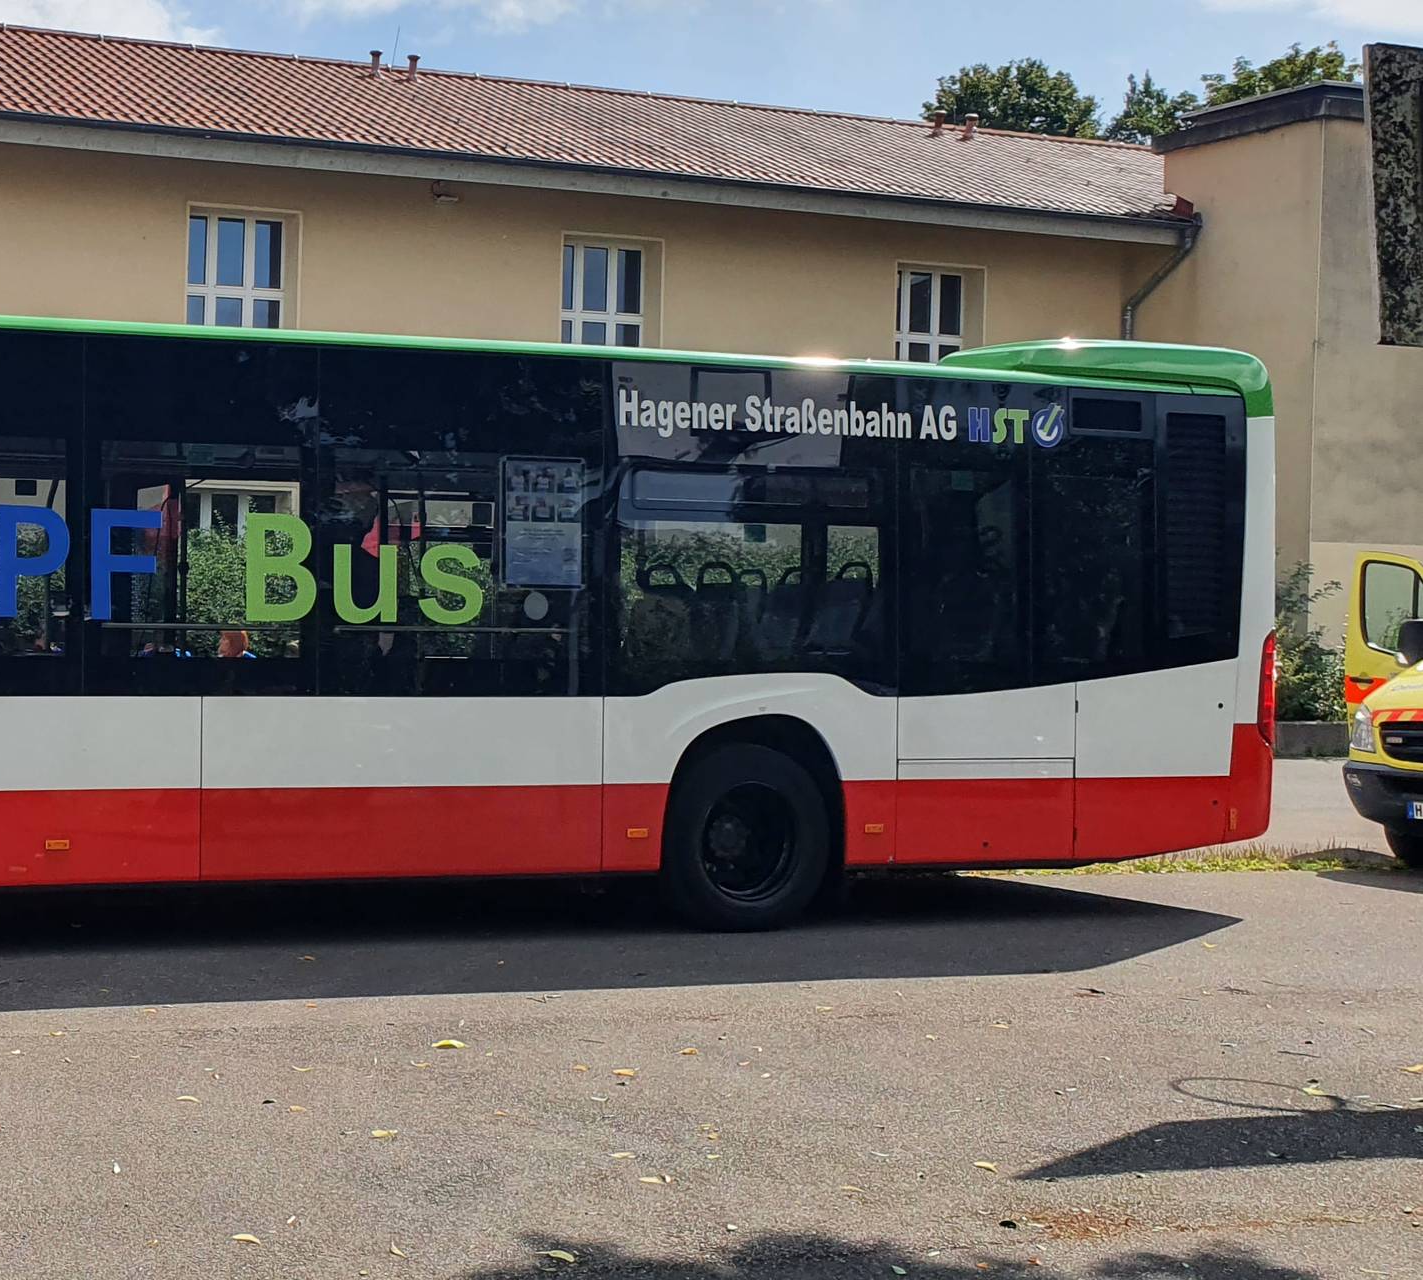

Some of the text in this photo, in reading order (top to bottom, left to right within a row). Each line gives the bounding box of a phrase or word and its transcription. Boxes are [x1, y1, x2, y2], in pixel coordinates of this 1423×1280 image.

[618, 388, 1029, 444] Hagener Straßenbahn AG HST
[245, 513, 485, 625] Bus
